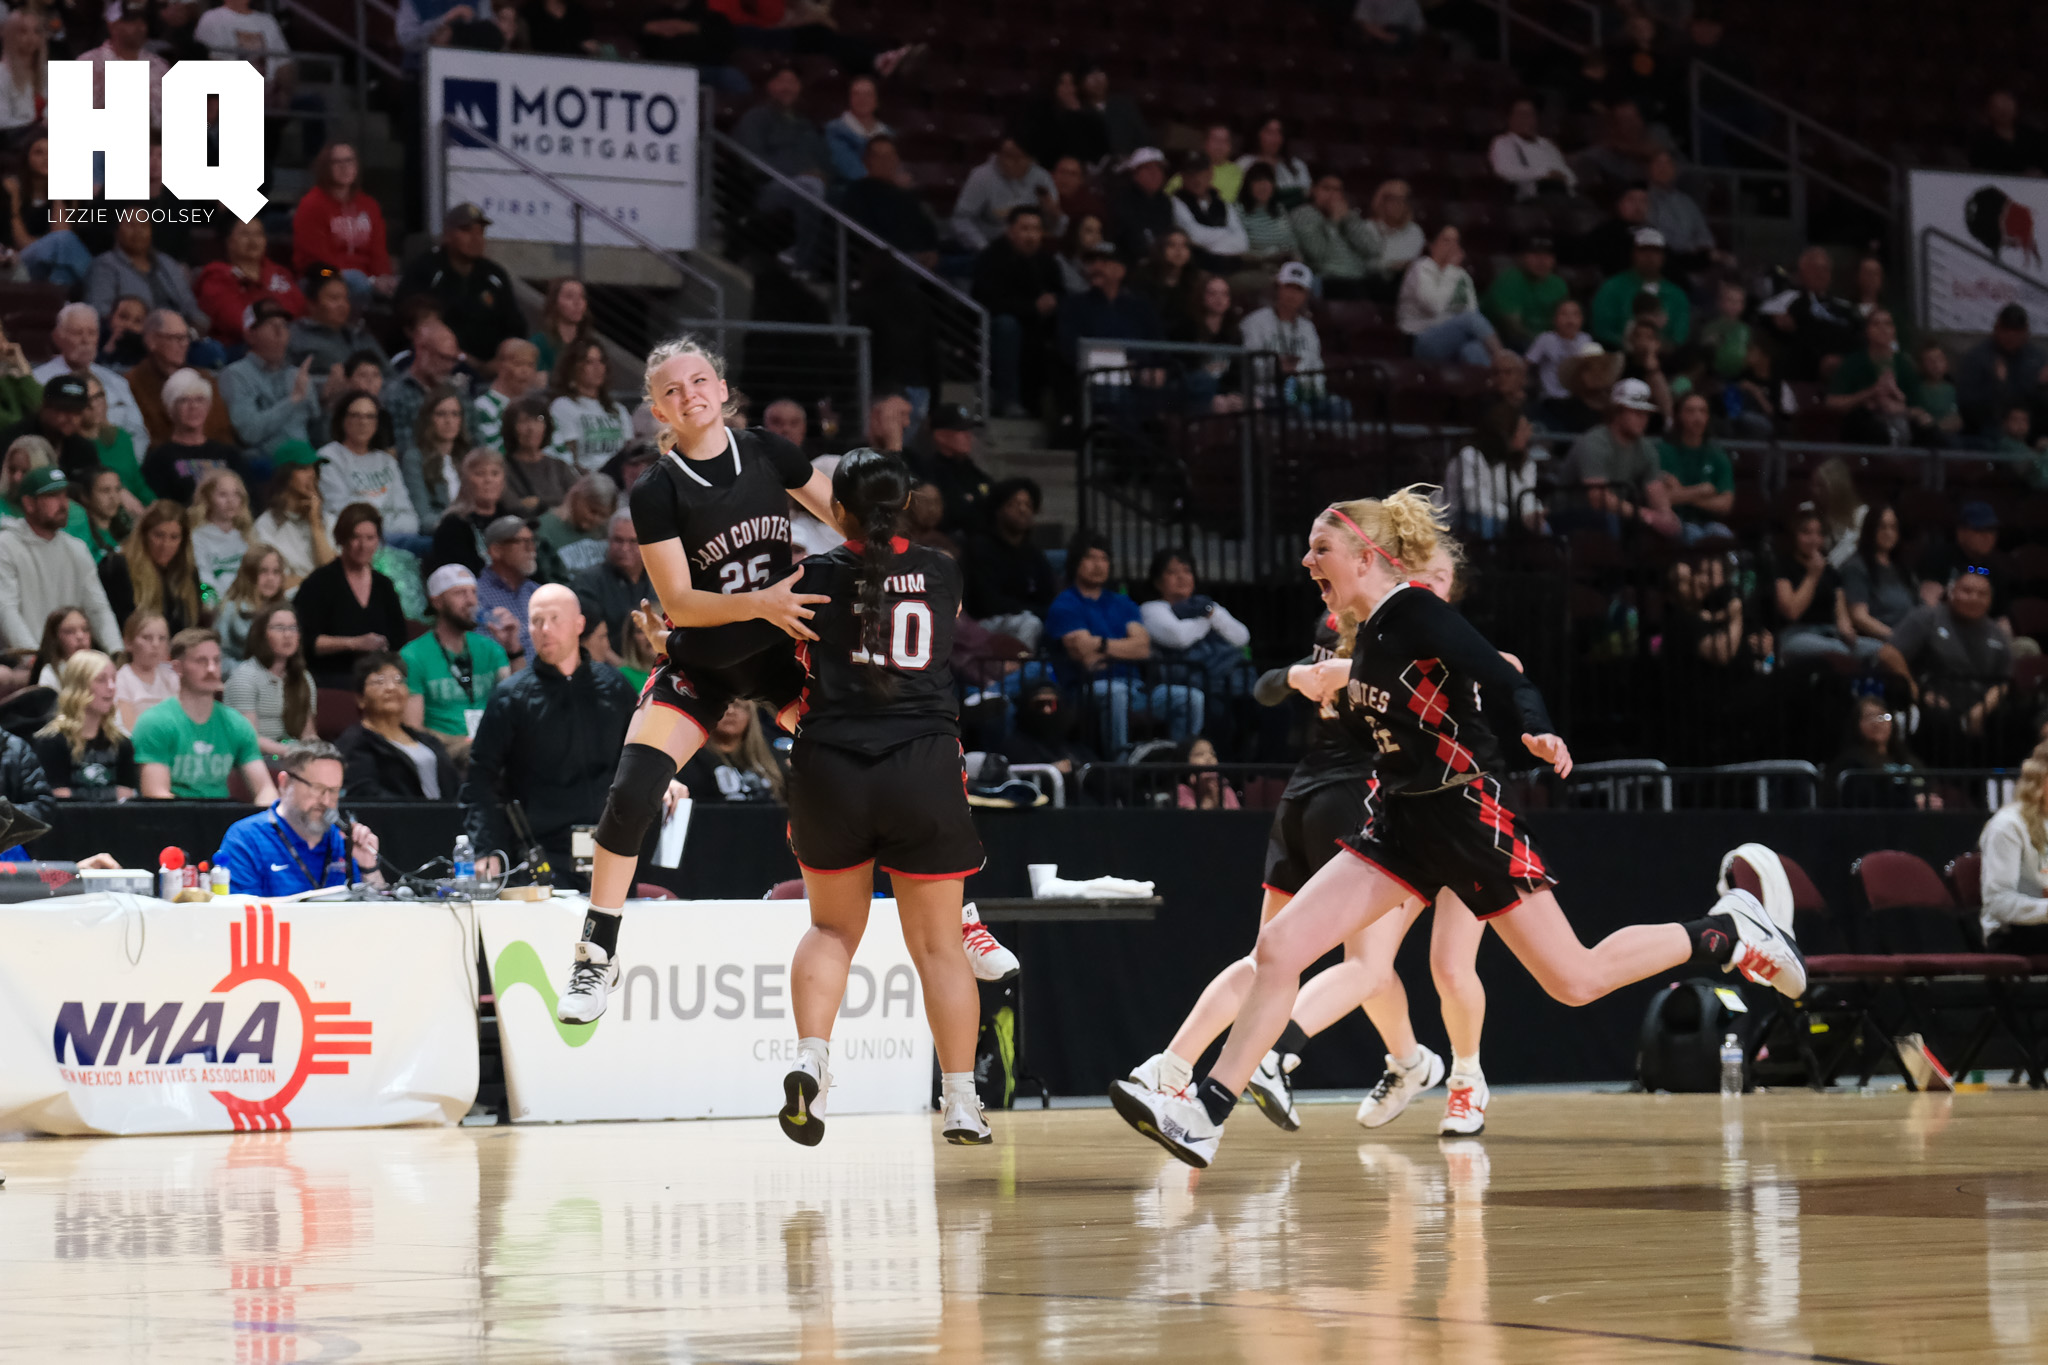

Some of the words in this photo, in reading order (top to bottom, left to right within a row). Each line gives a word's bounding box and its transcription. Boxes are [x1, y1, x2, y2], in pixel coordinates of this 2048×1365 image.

[511, 85, 677, 136] MOTTO
[511, 134, 681, 164] MORTGAGE
[691, 532, 730, 571] LADY
[730, 515, 790, 550] COYOTES
[719, 553, 771, 595] 25
[854, 573, 927, 595] TTUM
[1313, 643, 1341, 662] TAT
[1347, 678, 1391, 714] OTES
[622, 963, 916, 1021] nUSEDA
[53, 1001, 281, 1066] NMAA
[844, 1037, 914, 1061] UNION
[78, 1071, 122, 1086] MEXICO
[128, 1068, 197, 1086] ACTIVITIES
[201, 1068, 276, 1084] ASSOCIATION
